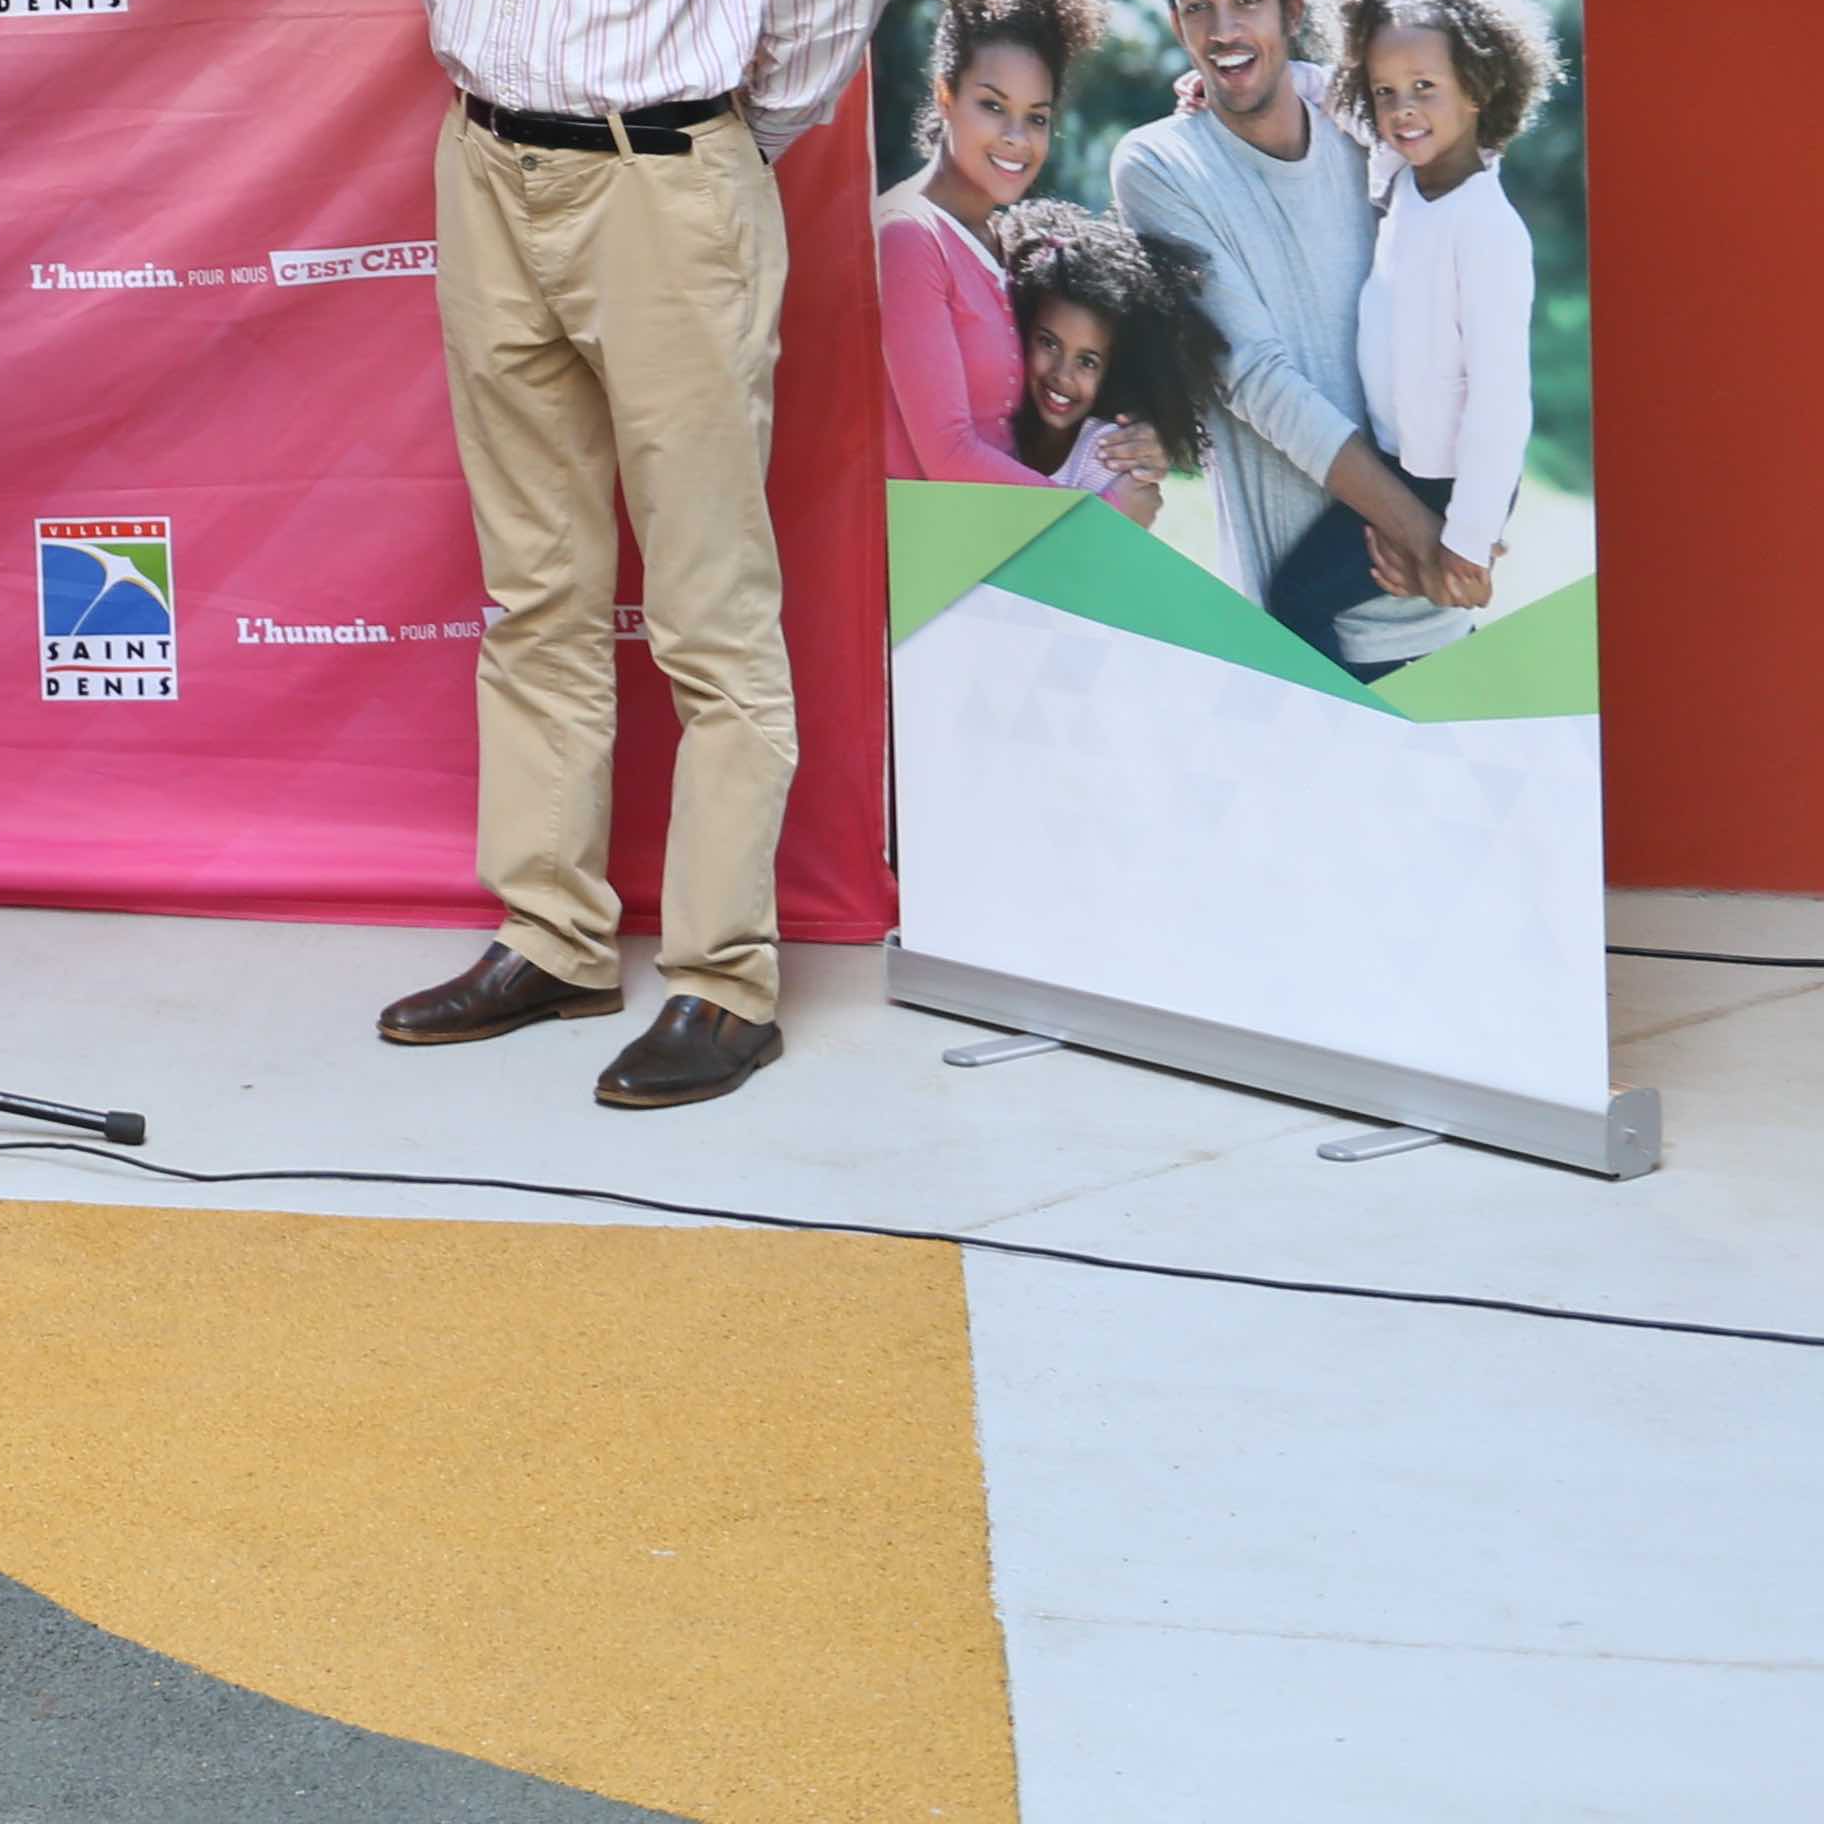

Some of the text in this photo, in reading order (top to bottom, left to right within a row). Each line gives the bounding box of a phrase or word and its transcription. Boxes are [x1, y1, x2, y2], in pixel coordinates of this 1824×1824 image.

[189, 268, 225, 286] POUR
[231, 266, 268, 284] NOUS
[279, 258, 353, 282] C'EST
[49, 525, 158, 537] VILLE DE
[400, 626, 439, 641] POUR
[444, 623, 480, 638] NOUS
[47, 641, 171, 661] SAINT
[47, 677, 171, 697] DENIS
